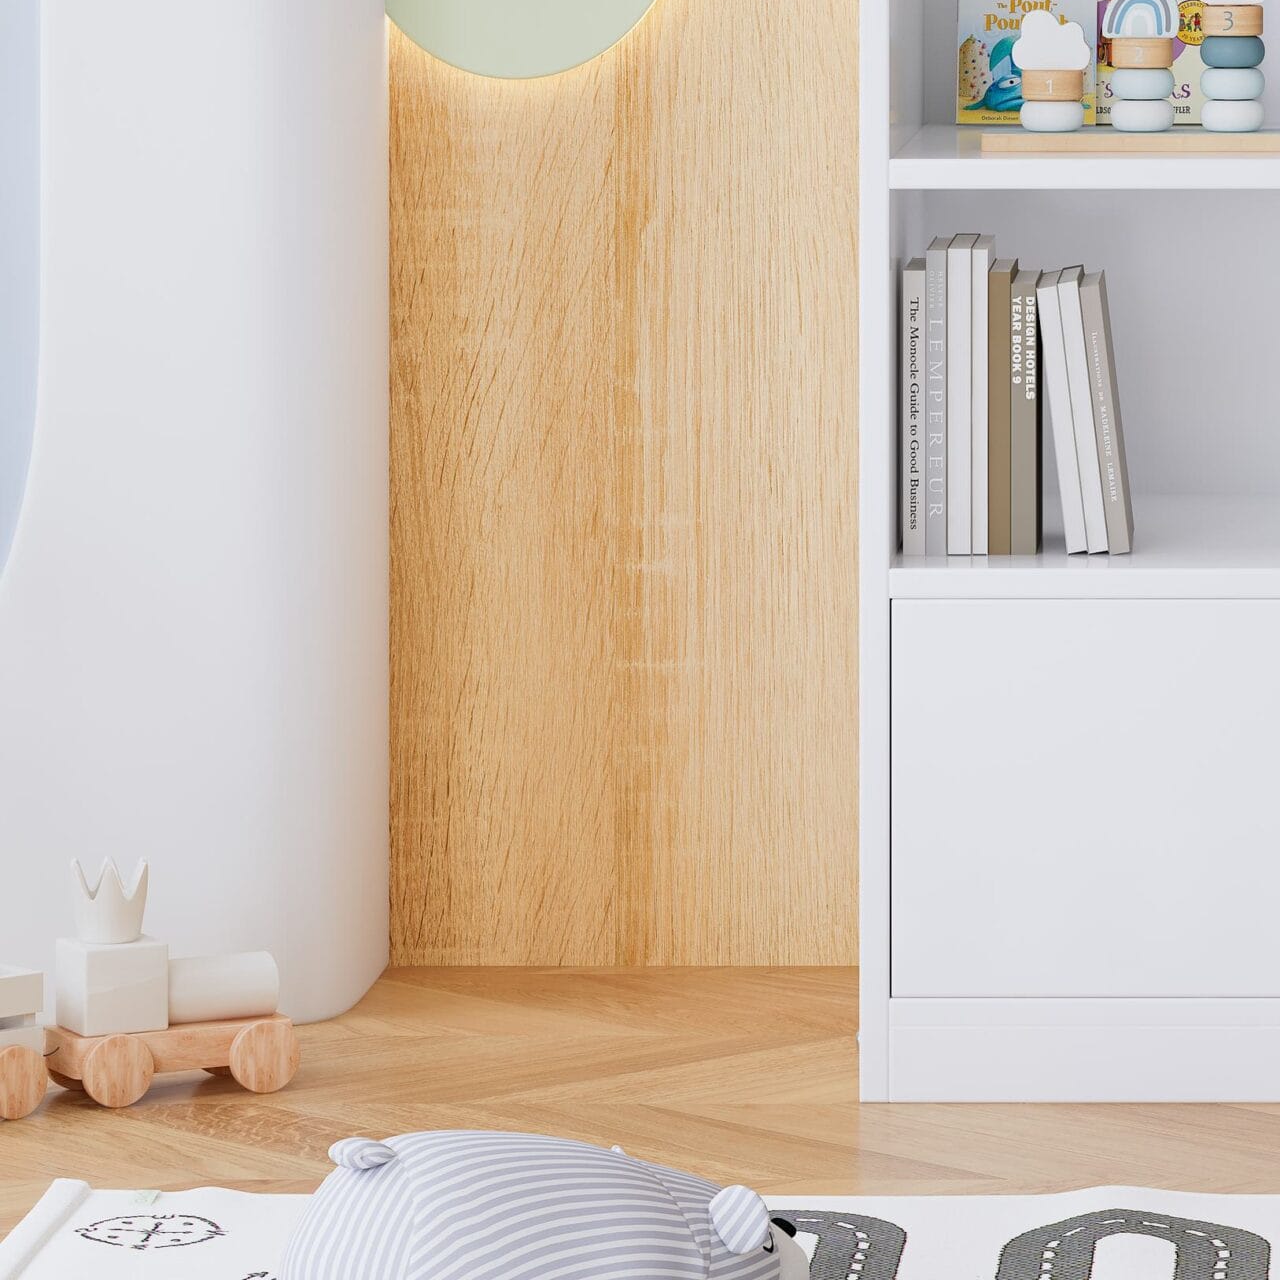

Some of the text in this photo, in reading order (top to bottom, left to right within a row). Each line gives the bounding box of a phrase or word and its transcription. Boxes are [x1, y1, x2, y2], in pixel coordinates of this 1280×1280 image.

[983, 13, 1025, 32] Pou
[1135, 47, 1144, 64] 2
[1222, 11, 1234, 31] 3
[1045, 79, 1054, 96] 1
[1012, 296, 1022, 384] YEAR BOOK 9
[1025, 296, 1035, 400] DESIGN HOTELS
[909, 297, 920, 530] The Monocle Guide to Good Business
[928, 318, 944, 520] LEMPEREUR
[1099, 406, 1113, 458] MADELEINE
[1106, 462, 1118, 503] LEMAIRE
